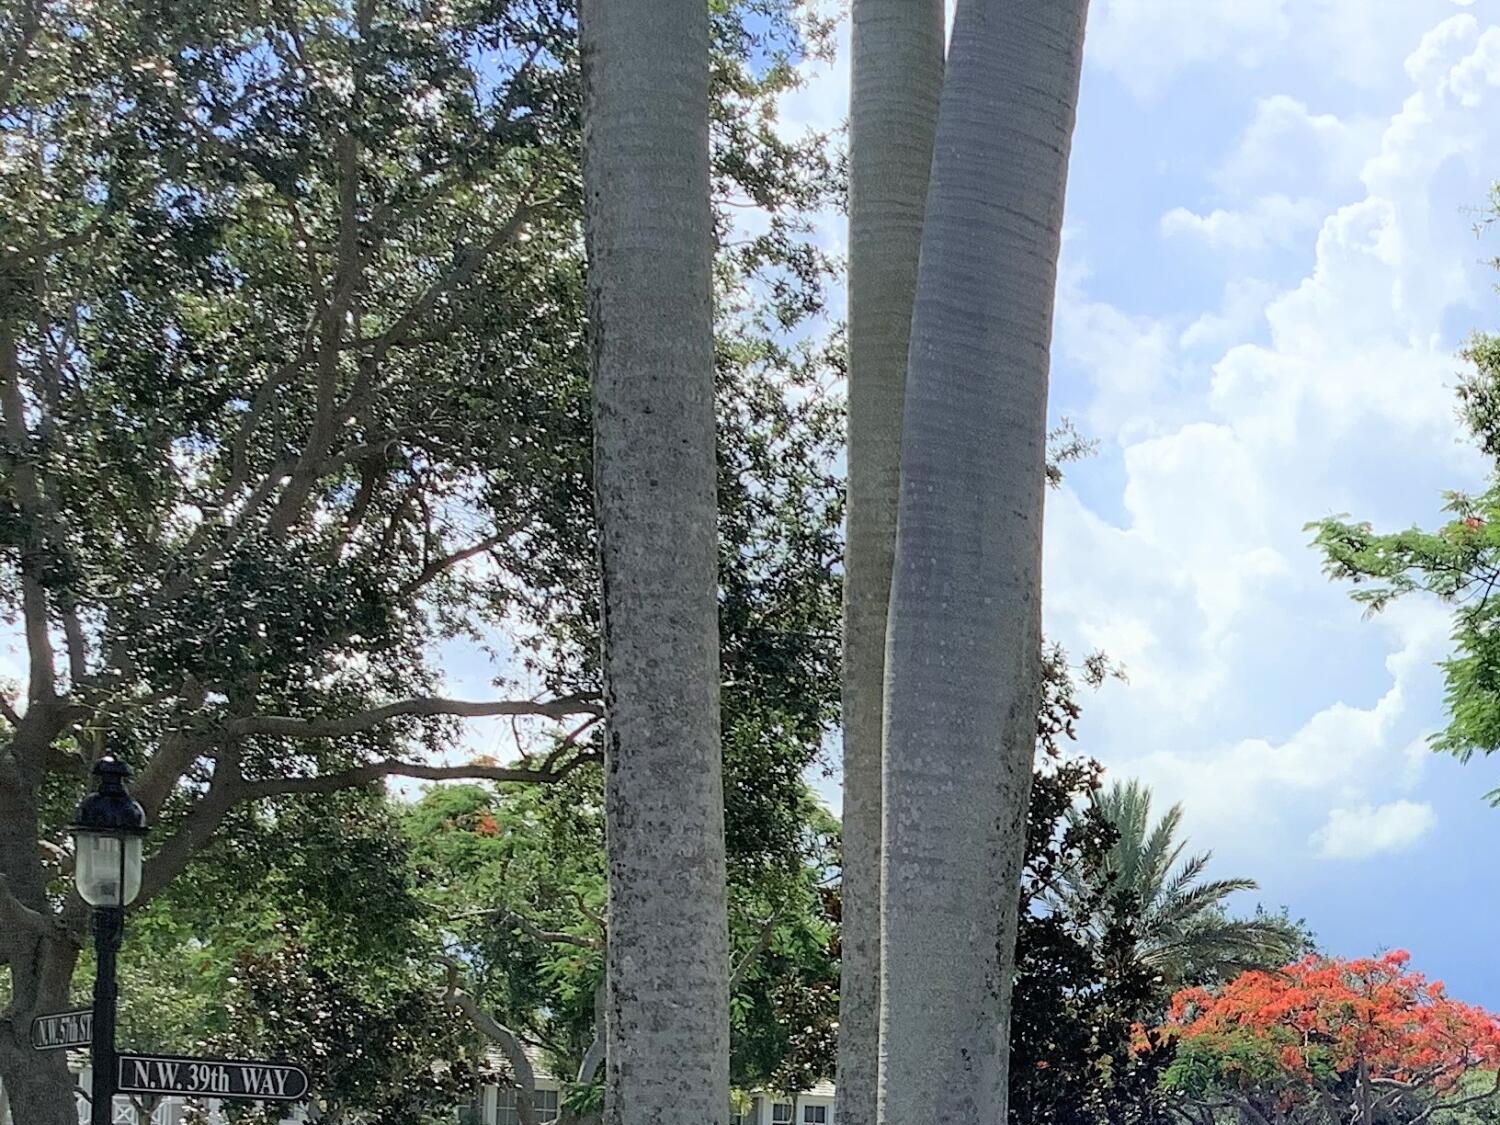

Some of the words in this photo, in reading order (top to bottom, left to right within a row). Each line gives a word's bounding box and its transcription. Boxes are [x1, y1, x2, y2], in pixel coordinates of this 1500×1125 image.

[133, 1060, 183, 1090] N.W.
[187, 1063, 230, 1093] 39th
[241, 1067, 290, 1096] WAY
